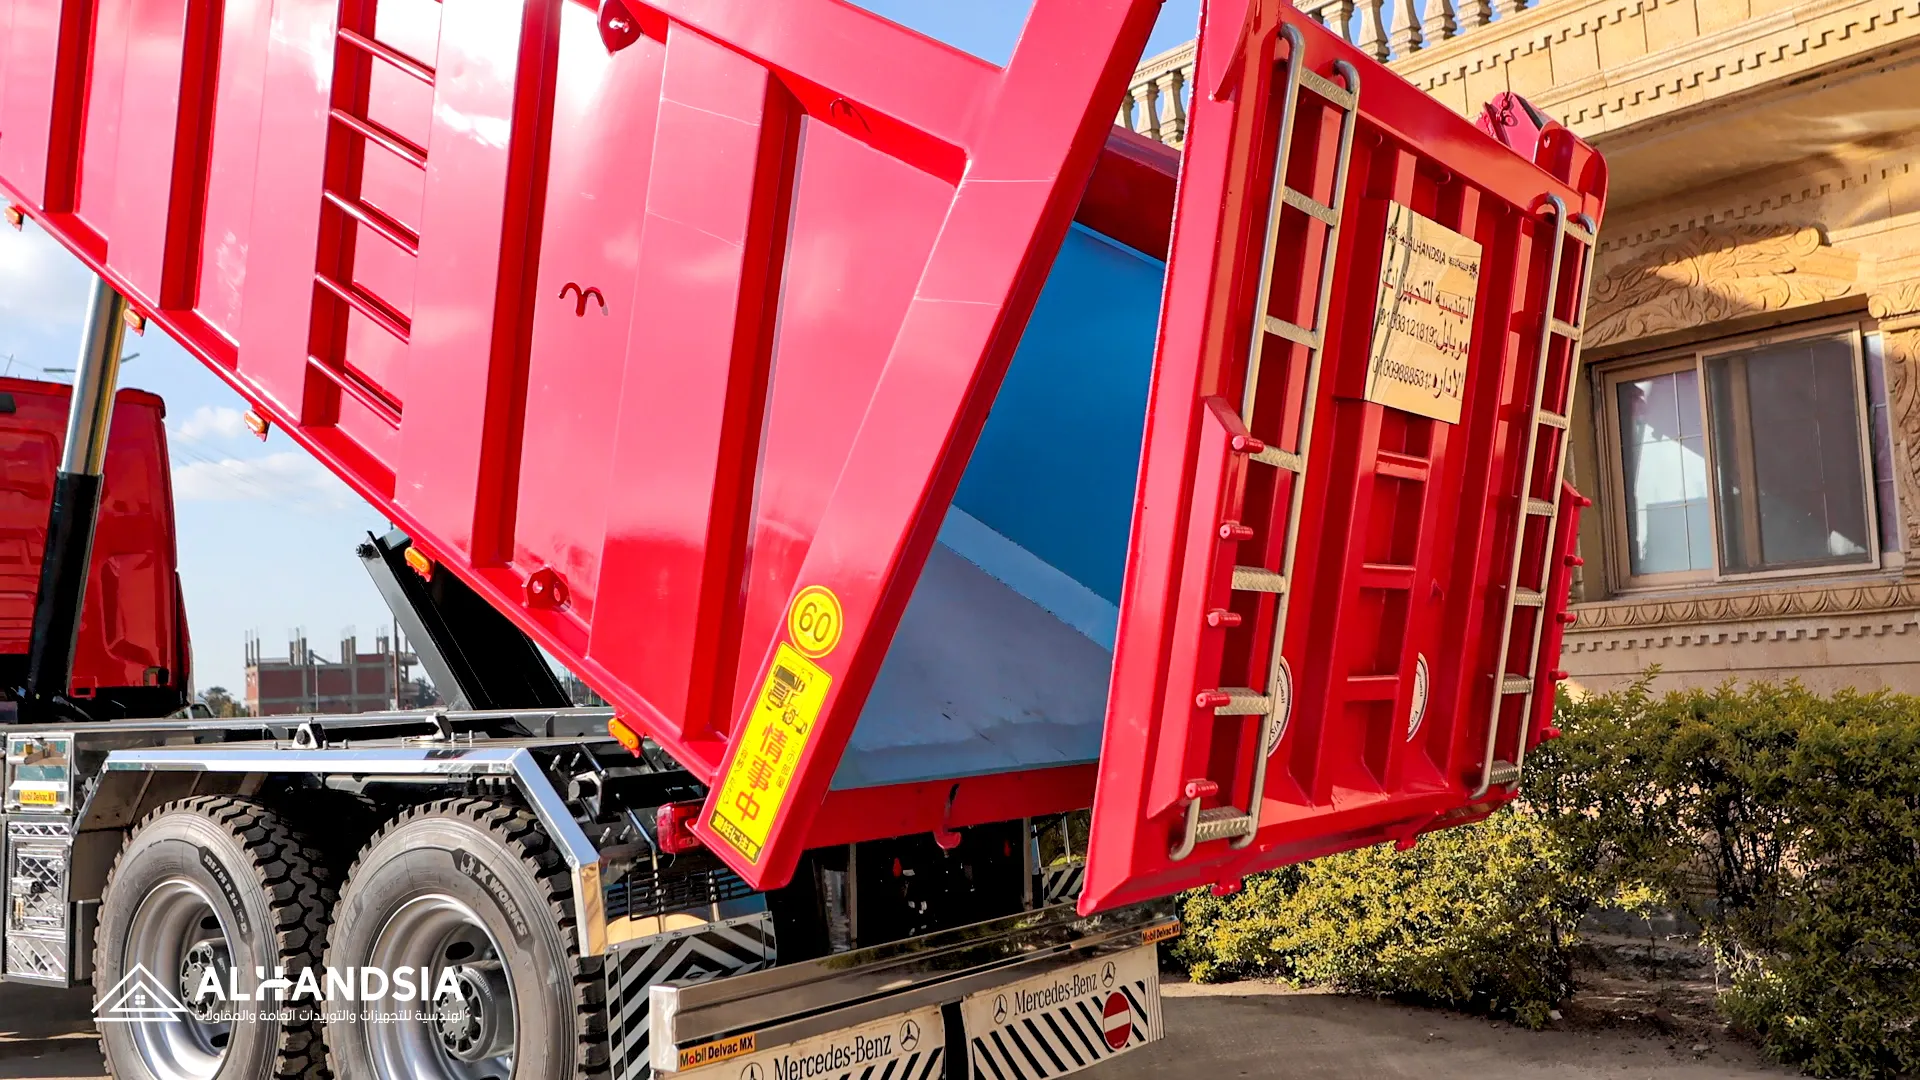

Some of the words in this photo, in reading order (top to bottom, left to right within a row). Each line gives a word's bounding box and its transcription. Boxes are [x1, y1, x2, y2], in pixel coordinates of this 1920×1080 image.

[1407, 237, 1446, 265] ALHANDSIA
[799, 602, 831, 642] 60
[475, 866, 488, 881] X
[488, 876, 527, 937] WORKS
[1013, 973, 1098, 1016] Mercedes-Benz
[679, 1047, 707, 1068] Mobil
[708, 1042, 738, 1060] Delvac
[739, 1036, 753, 1052] MX
[773, 1034, 892, 1080] Mercedes-Benz
